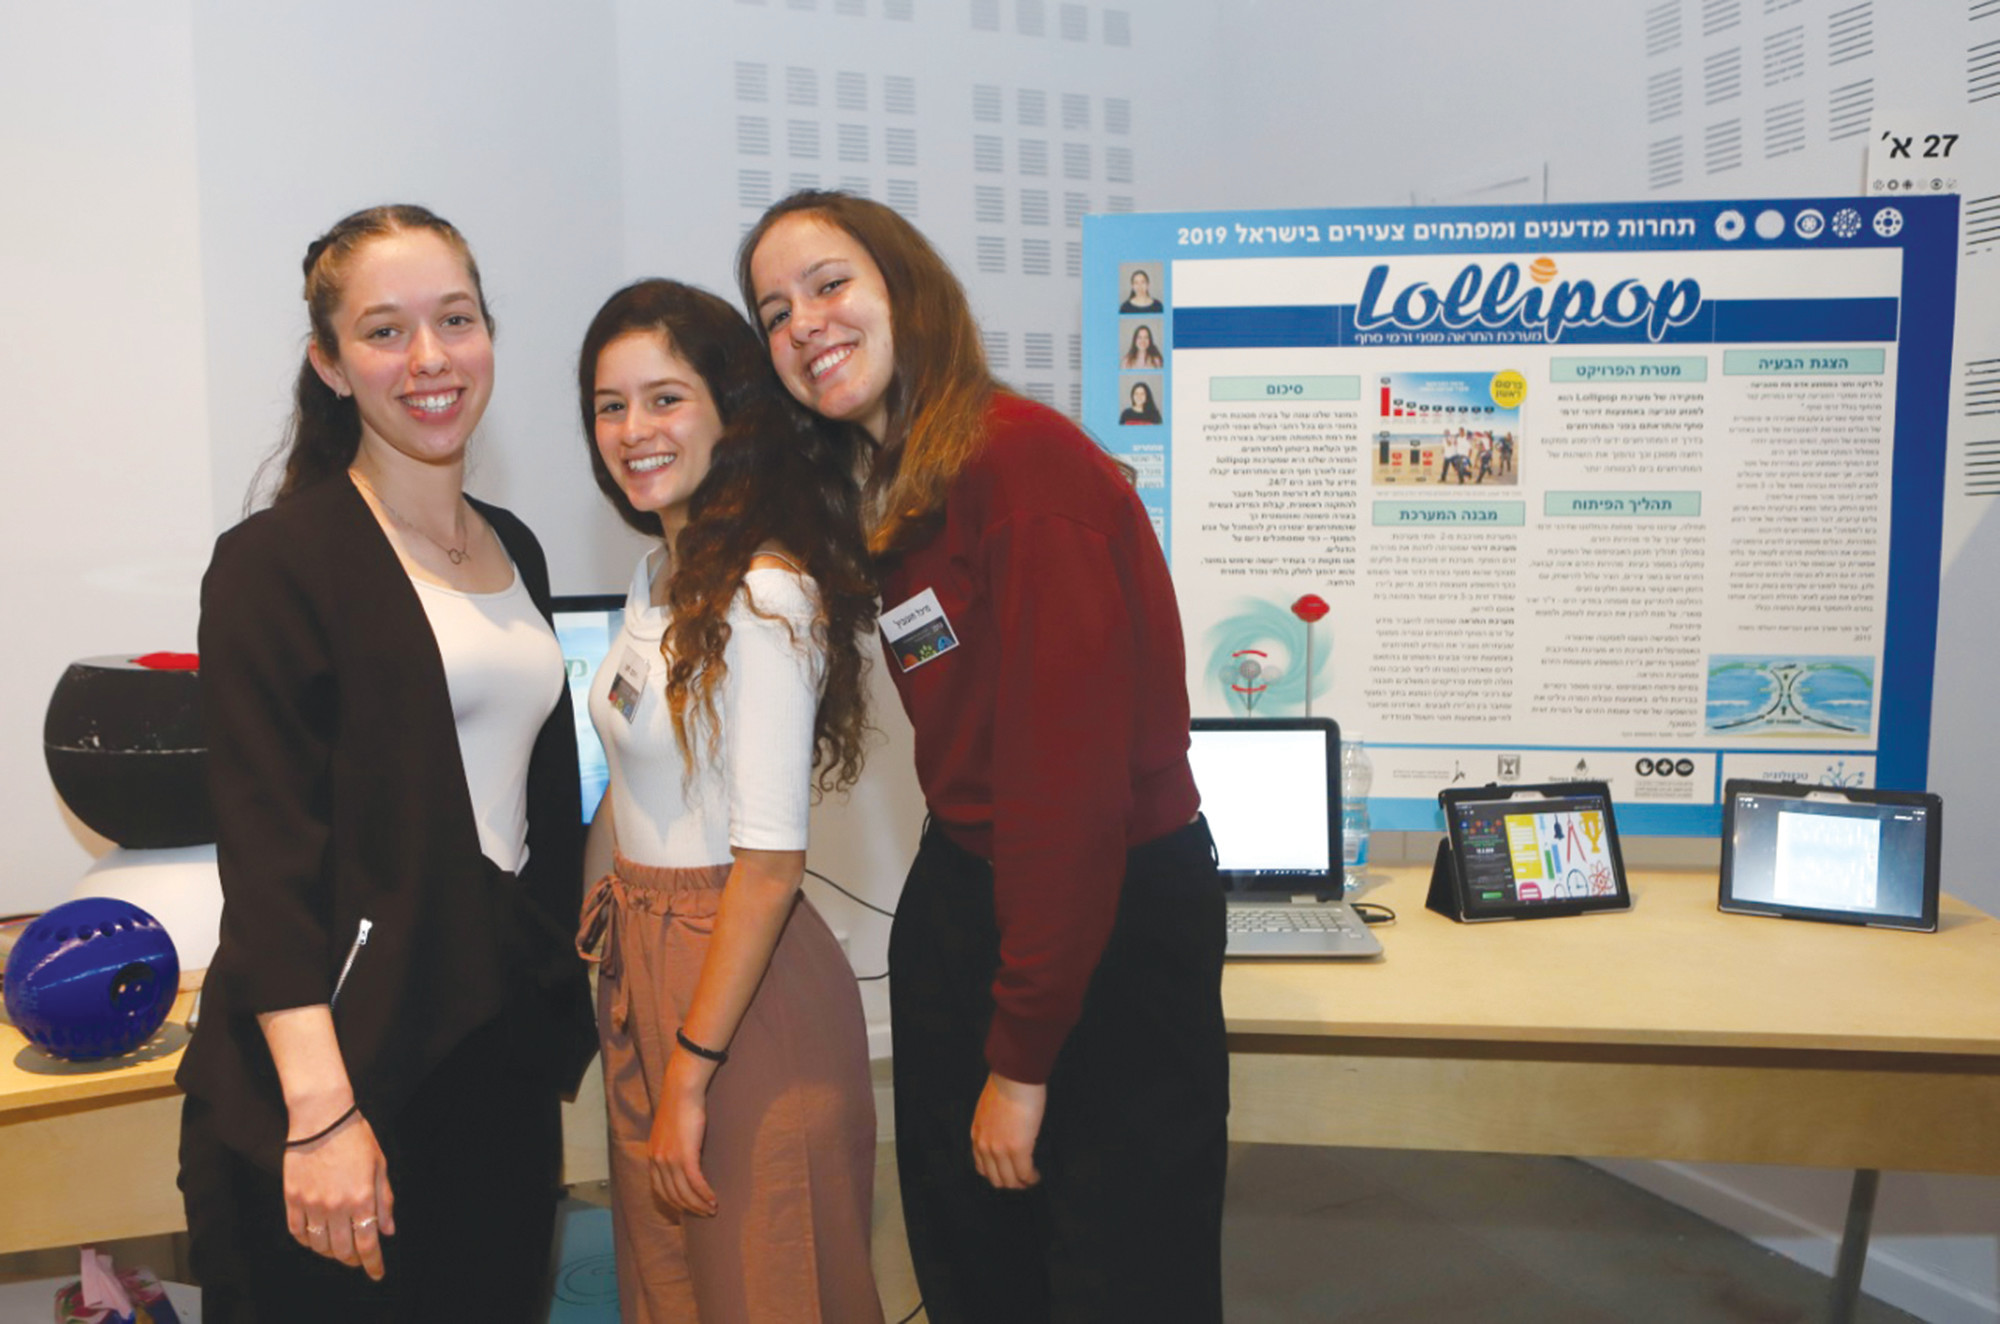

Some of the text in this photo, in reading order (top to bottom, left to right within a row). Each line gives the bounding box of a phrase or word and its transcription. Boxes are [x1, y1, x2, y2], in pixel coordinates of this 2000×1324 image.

[1922, 134, 1959, 158] 27
[1178, 218, 1696, 246] תחרות מדענים ומפתחים צעירים בישראל 2019
[1354, 256, 1701, 343] Lollipop
[1354, 331, 1542, 345] מערכת התראה מפני זרמי סחף
[1758, 358, 1848, 370] הצגת הבעיה
[1576, 365, 1681, 378] מטרת הפרויקט
[1266, 384, 1304, 395] סיכום
[1572, 497, 1672, 512] תהליך הפיתוח
[1400, 510, 1498, 521] מבנה המערכת
